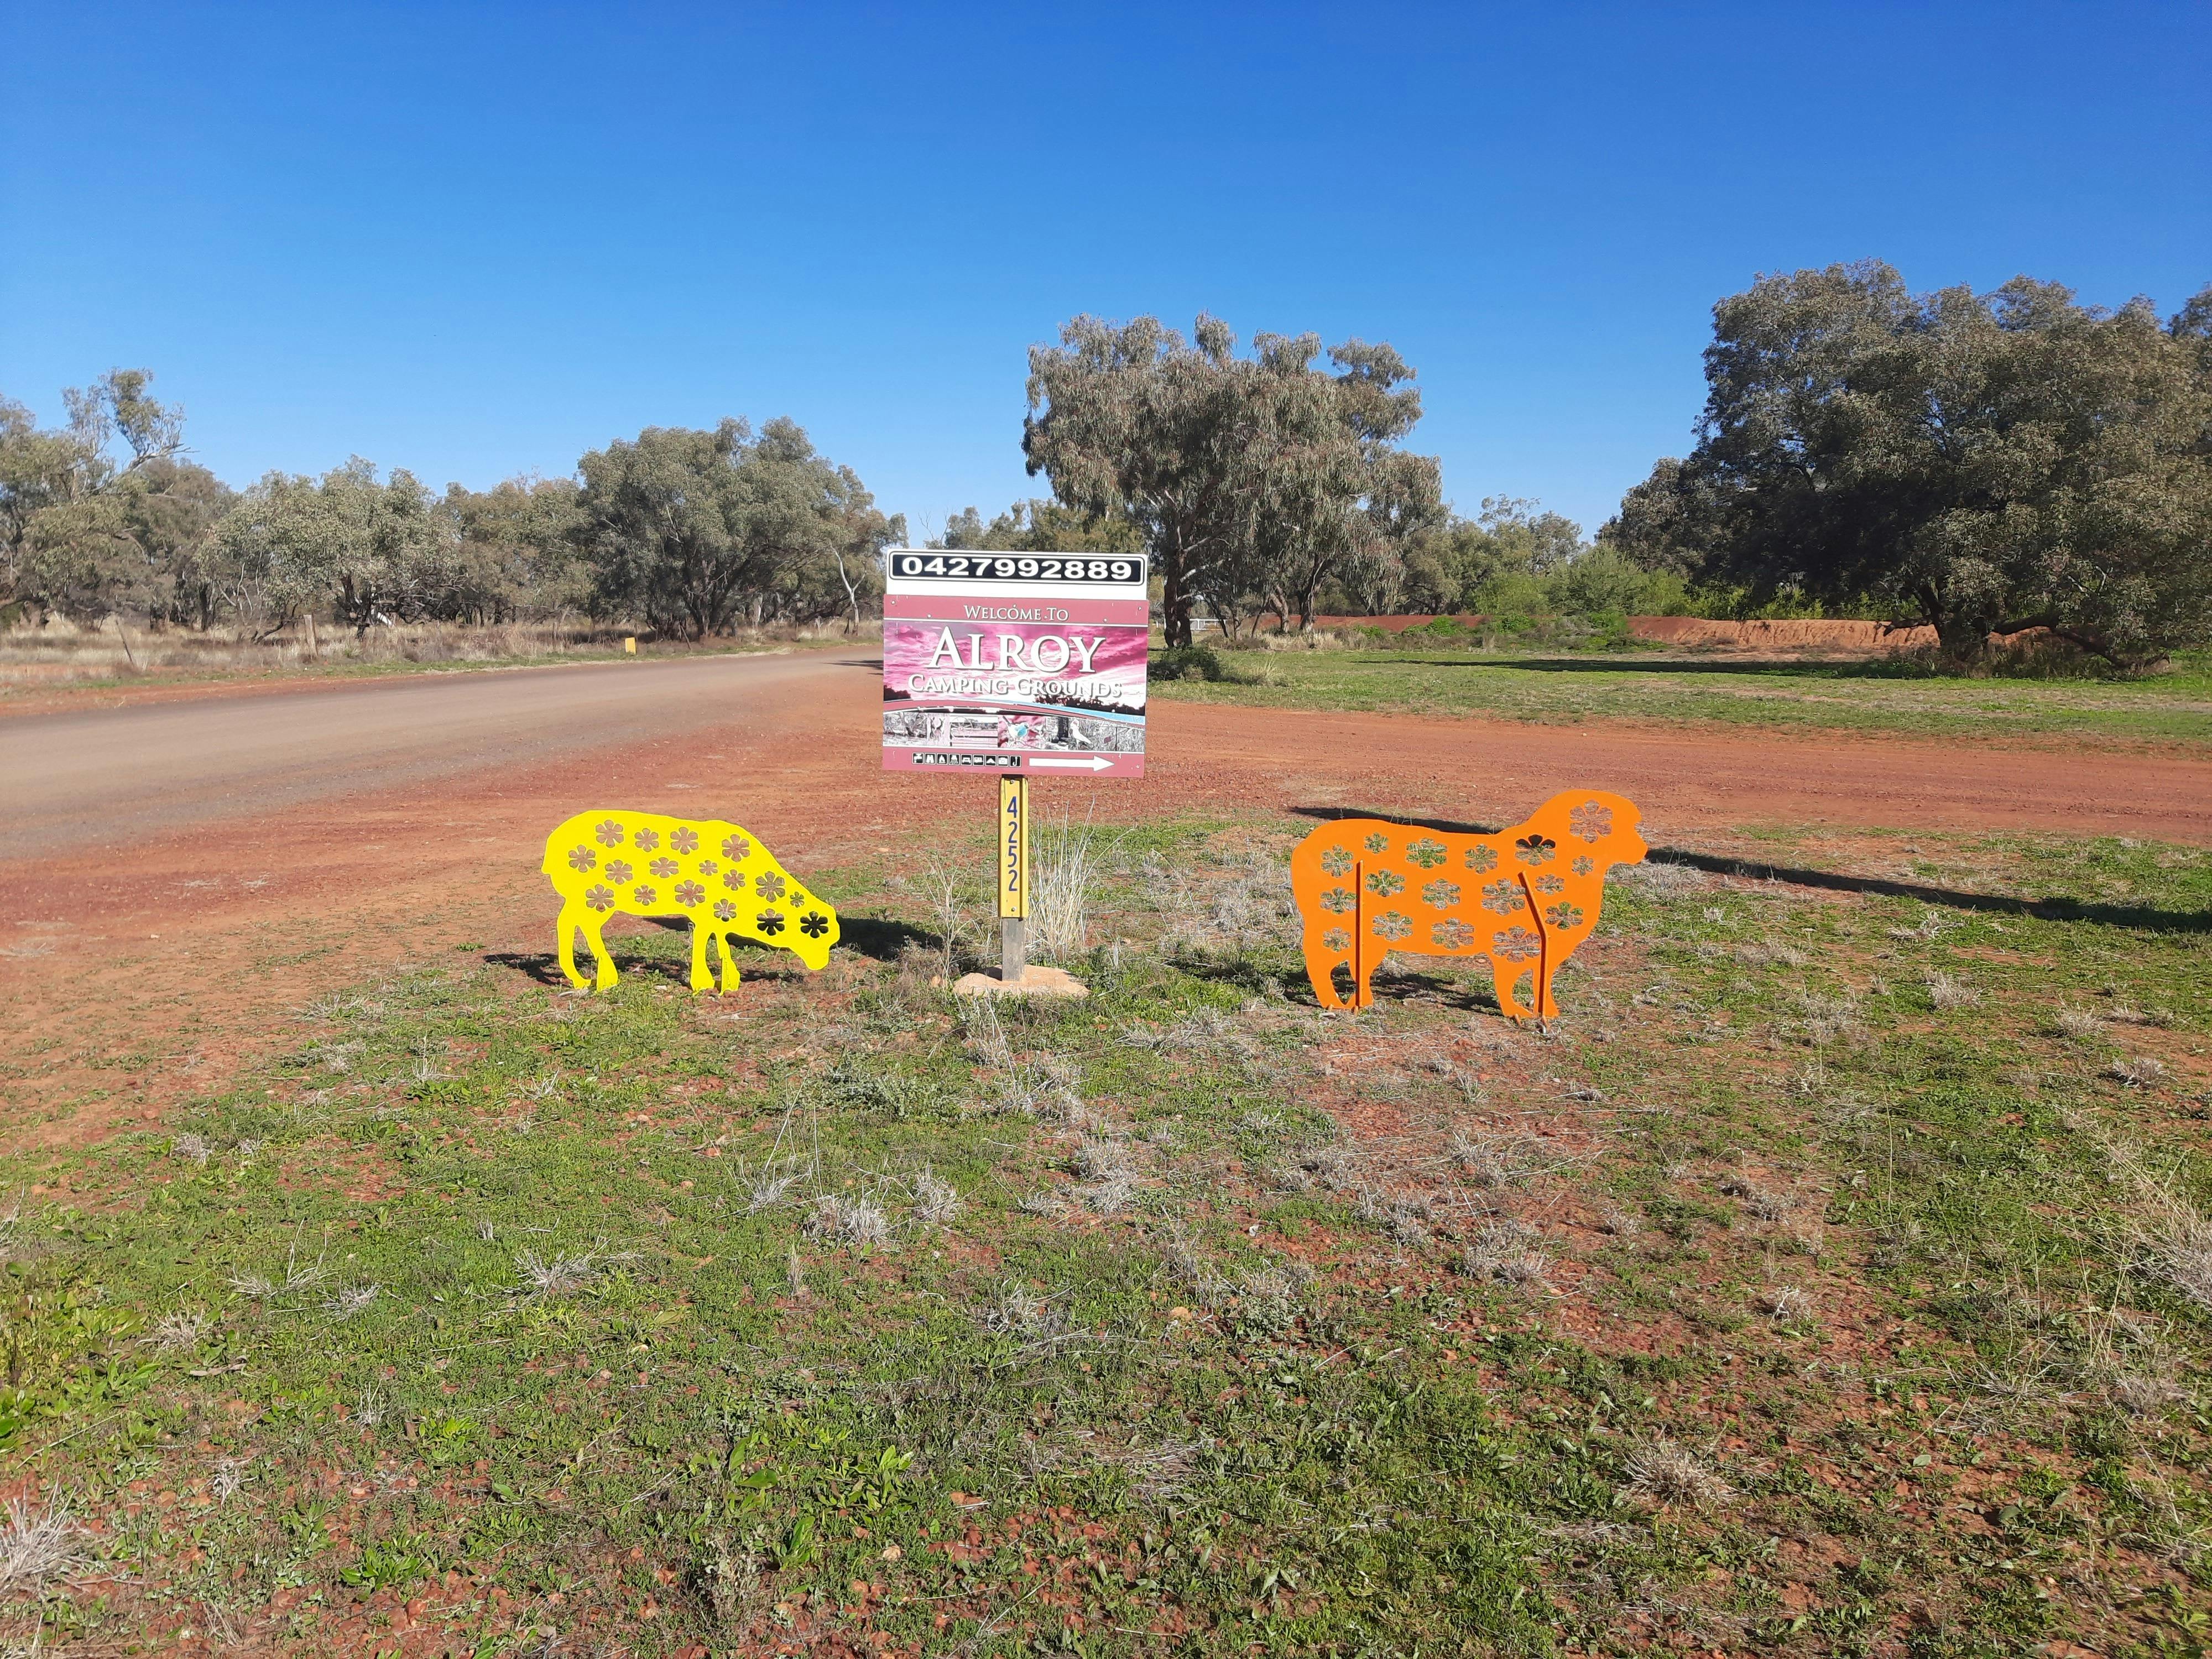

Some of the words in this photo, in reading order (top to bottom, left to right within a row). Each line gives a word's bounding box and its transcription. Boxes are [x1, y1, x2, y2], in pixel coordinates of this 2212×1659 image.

[902, 557, 1131, 580] 0427992889
[964, 606, 1041, 620] WELCOME
[927, 626, 1106, 672] ALROY
[909, 674, 1010, 695] CAMPING
[1016, 679, 1122, 698] GROUNDS
[1006, 796, 1018, 891] 4252
